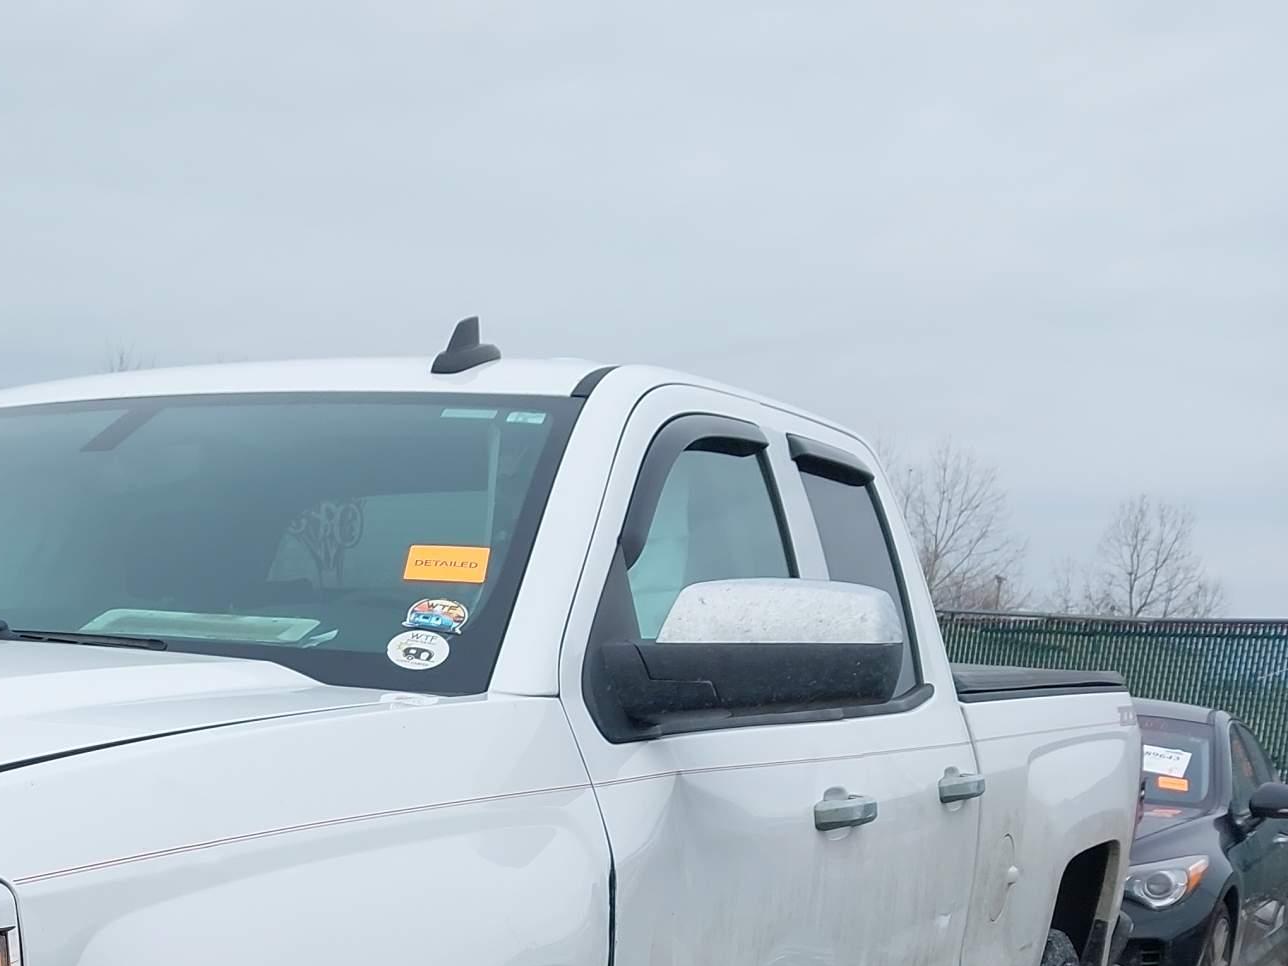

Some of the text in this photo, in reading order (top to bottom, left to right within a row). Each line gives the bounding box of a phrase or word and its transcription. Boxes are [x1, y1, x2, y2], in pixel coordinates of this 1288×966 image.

[413, 558, 479, 570] DETAILED
[425, 600, 460, 613] WTF
[410, 632, 438, 643] WTF
